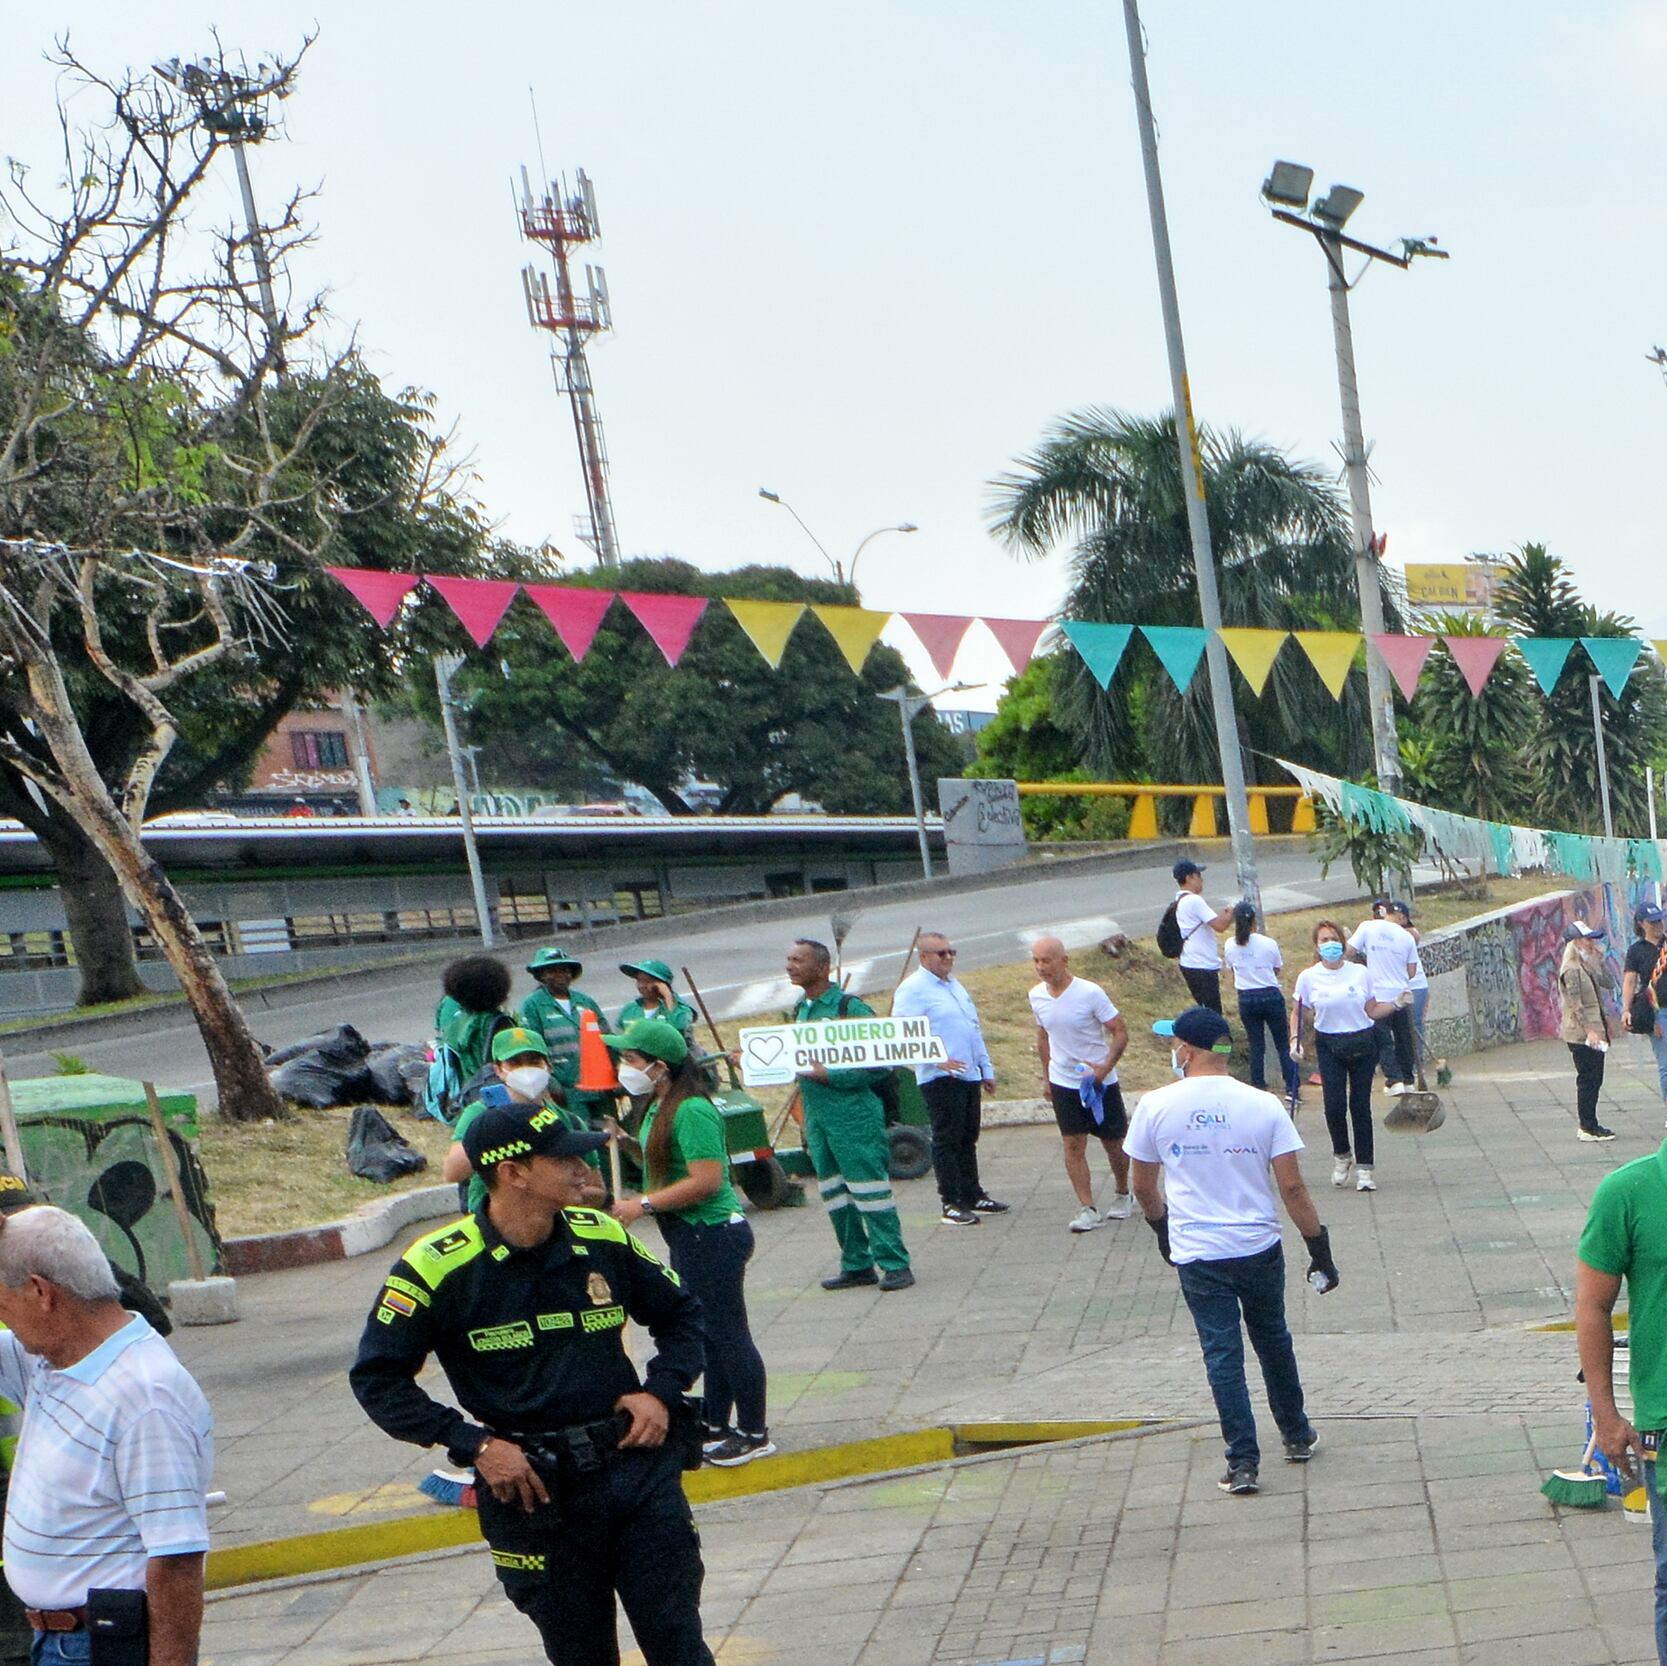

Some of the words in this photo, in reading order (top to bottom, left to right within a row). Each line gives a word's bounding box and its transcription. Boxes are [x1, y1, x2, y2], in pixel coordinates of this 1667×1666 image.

[793, 1026, 818, 1046] YO
[825, 1021, 896, 1043] QUIERO
[903, 1020, 926, 1038] MI
[795, 1045, 868, 1068] CIUDAD
[873, 1040, 942, 1062] LIMPIA
[1196, 1114, 1226, 1124] CALI
